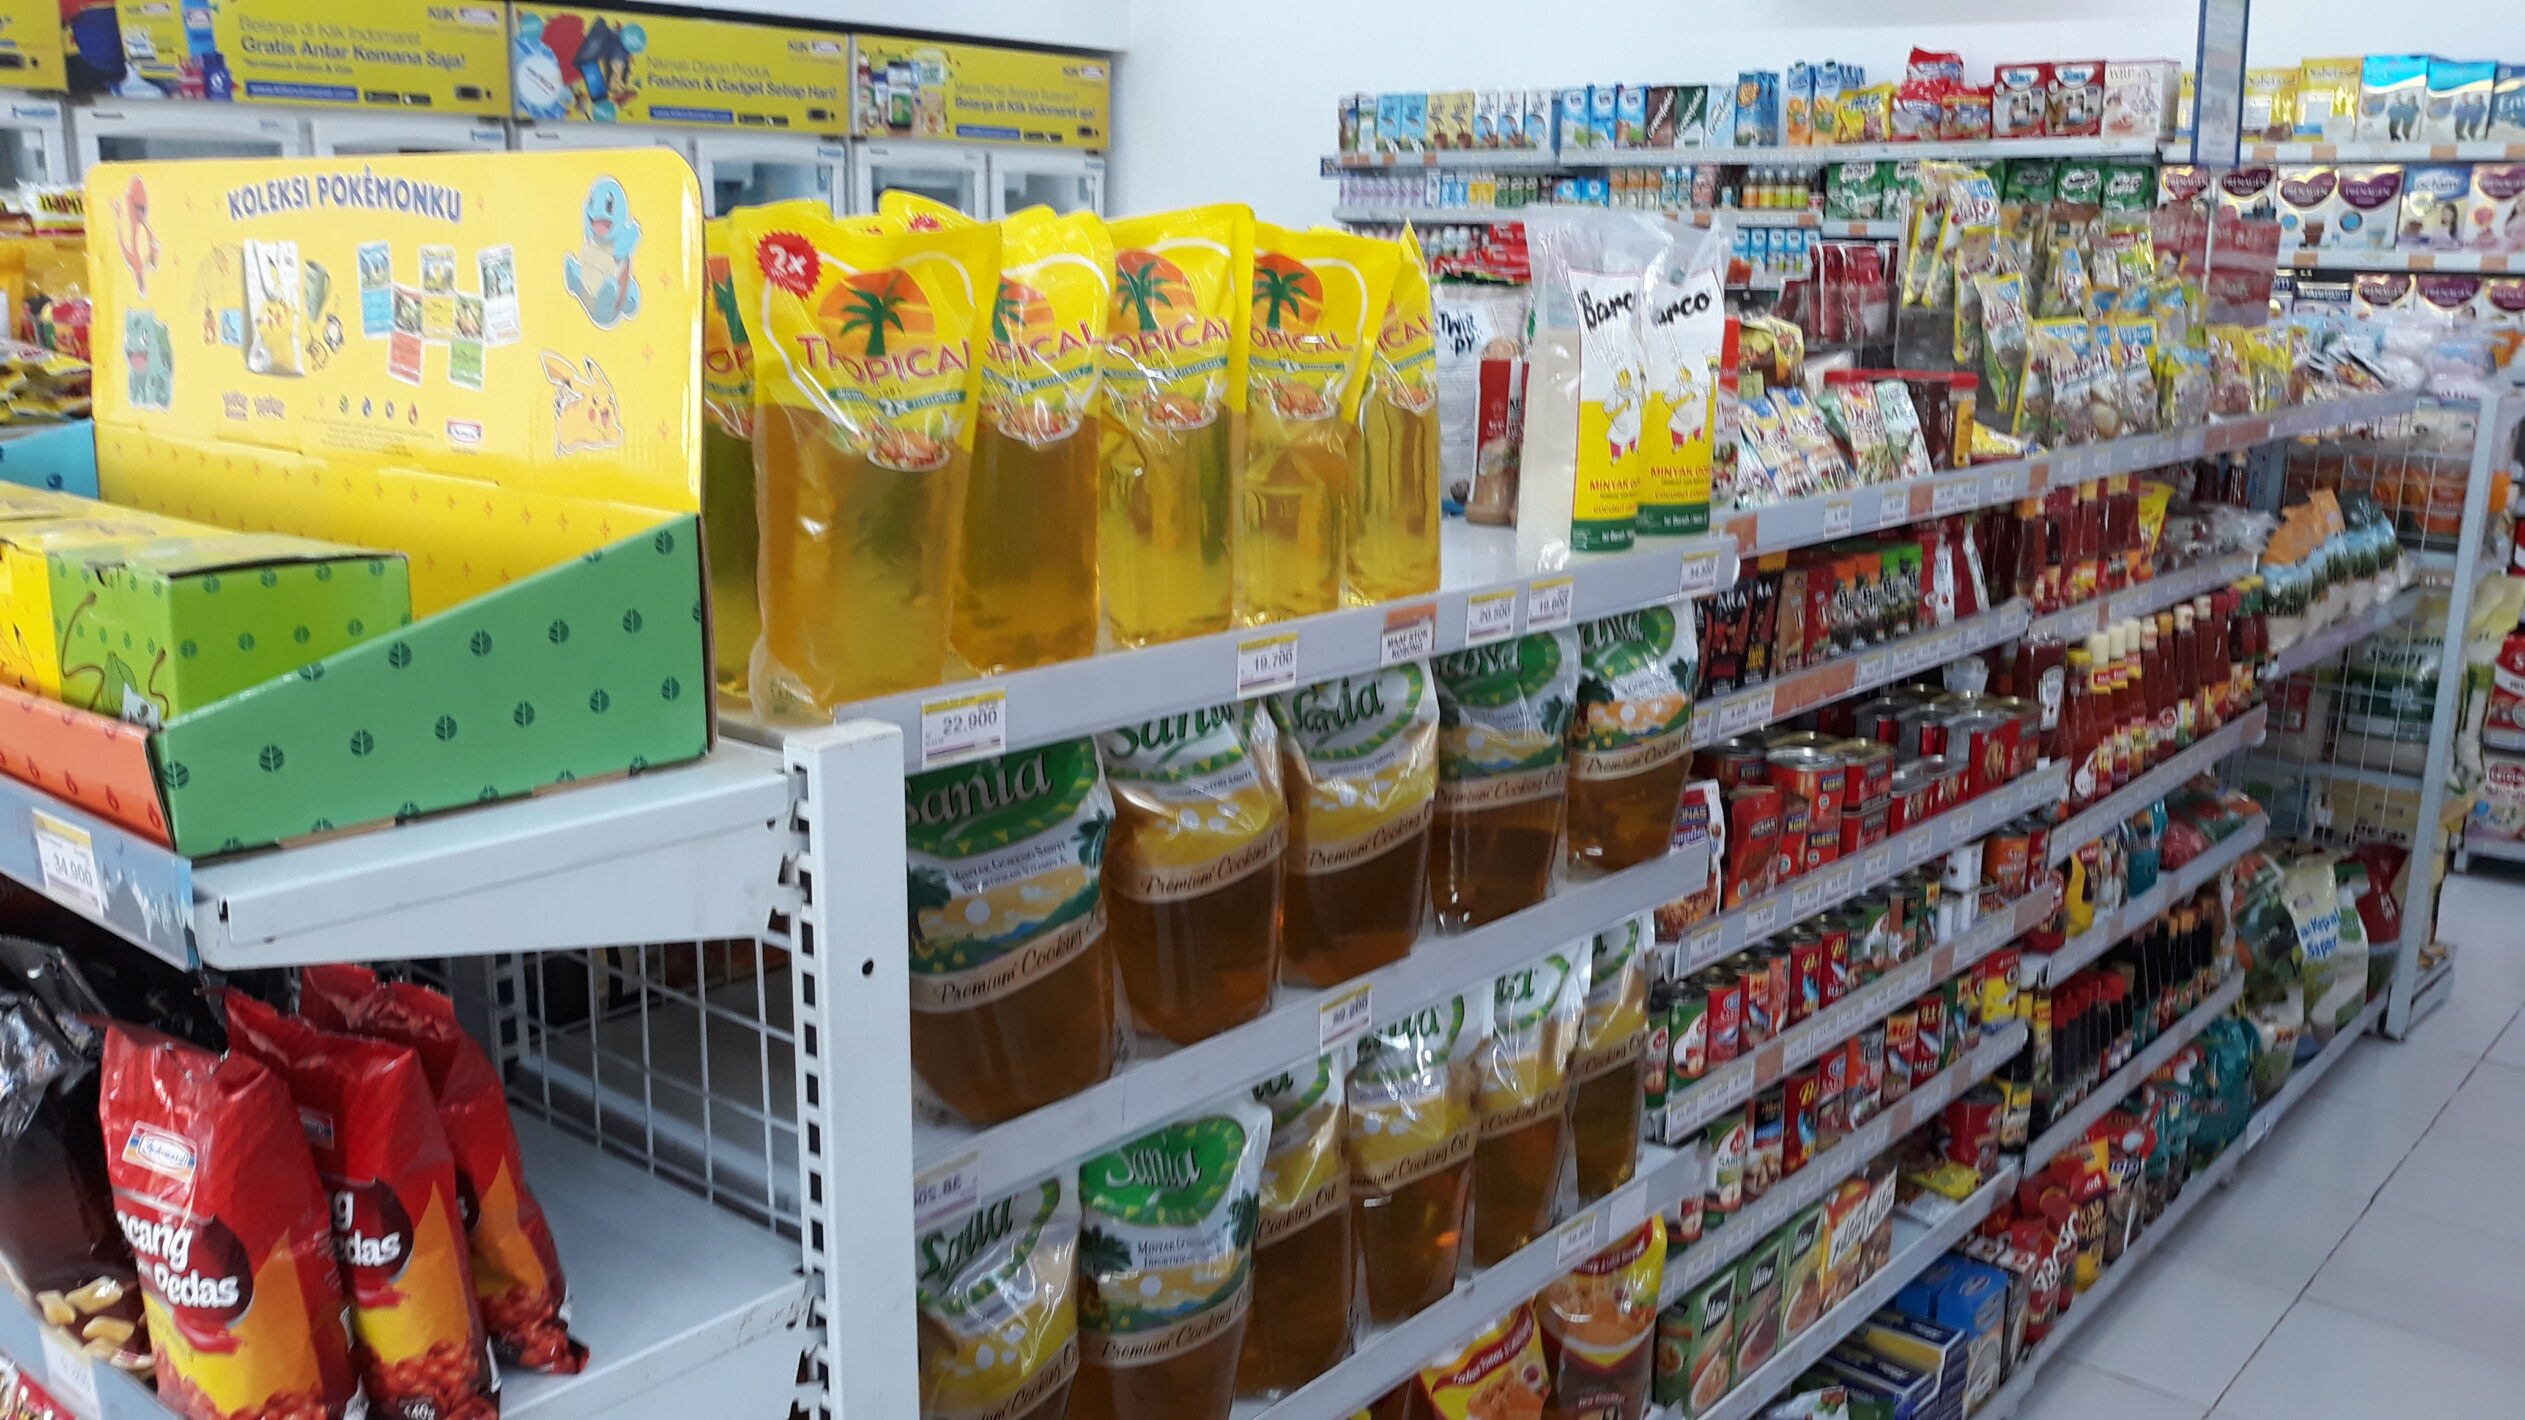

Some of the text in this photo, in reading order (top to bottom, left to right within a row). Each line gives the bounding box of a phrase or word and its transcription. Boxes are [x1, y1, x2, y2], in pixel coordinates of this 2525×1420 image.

[241, 36, 296, 55] Gratis
[302, 40, 348, 59] Antar
[353, 45, 422, 66] Kemana
[427, 51, 465, 71] Saja!
[648, 74, 701, 90] Fashion
[704, 77, 714, 91] &
[717, 78, 764, 97] Gadget
[767, 82, 805, 99] Setiap
[227, 163, 462, 224] KOLEKSI POKÉMONKU
[1494, 776, 1541, 799] Cooking
[1309, 812, 1421, 869] Premium Cooking
[1145, 872, 1213, 896] Premium
[1218, 841, 1268, 878] Cooking
[941, 930, 1084, 1005] Premium Cooking
[1488, 1103, 1539, 1134] Cooking
[1105, 1138, 1204, 1190] Sania
[1399, 1144, 1449, 1179] Cooking
[1451, 1132, 1470, 1157] Oil
[1258, 1184, 1339, 1235] Cooking Oil
[1102, 1310, 1232, 1361] Premium Cooking
